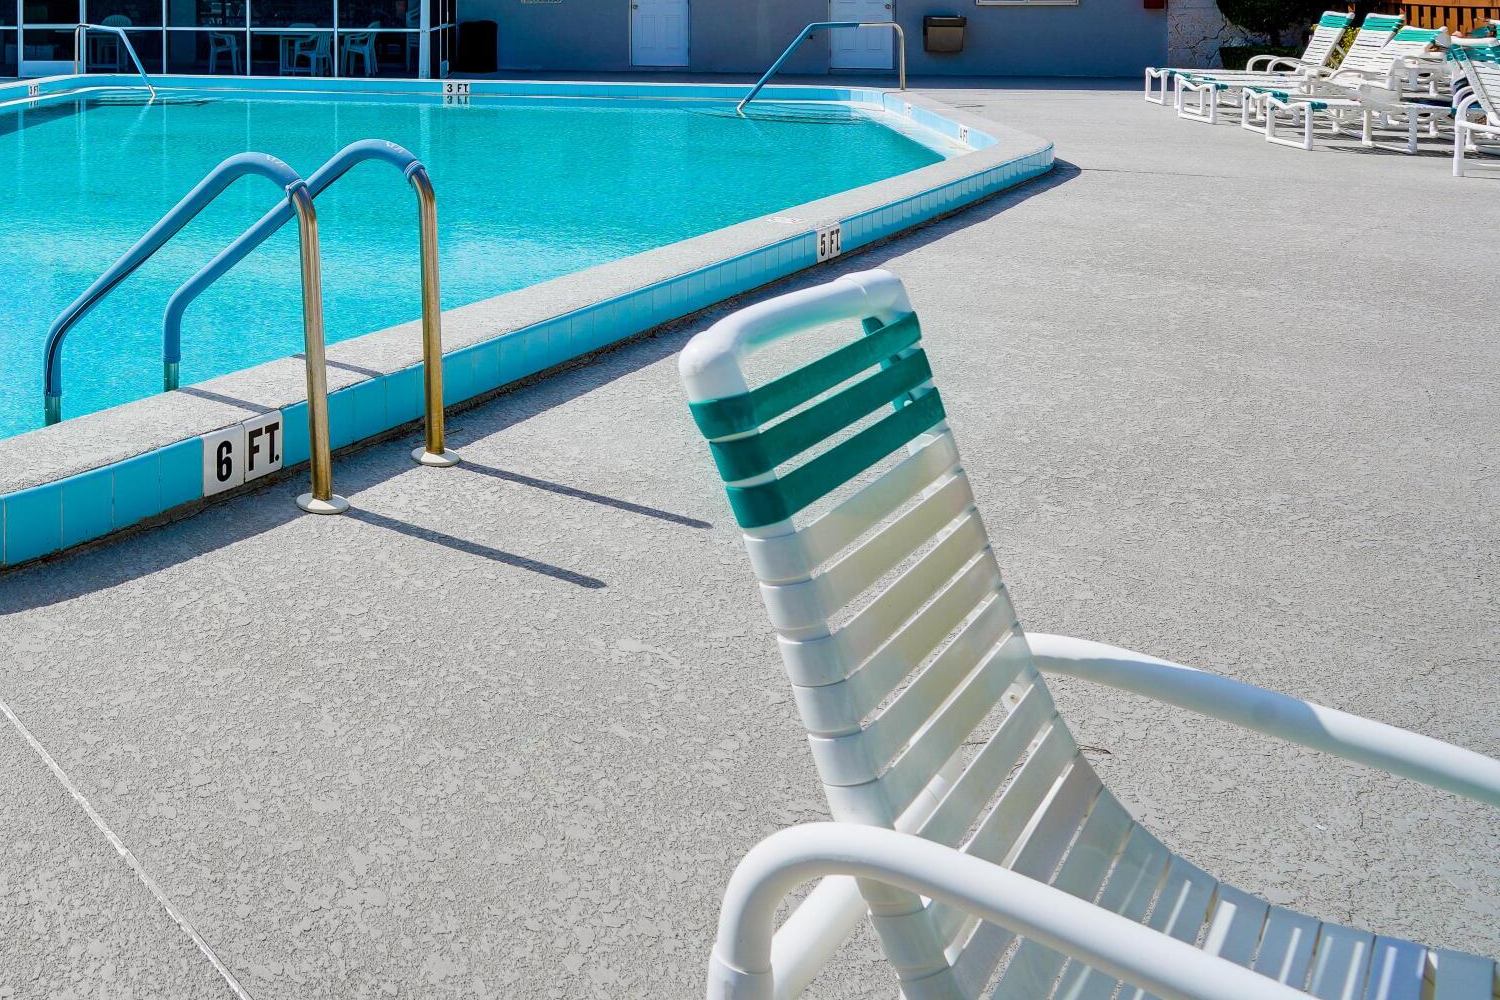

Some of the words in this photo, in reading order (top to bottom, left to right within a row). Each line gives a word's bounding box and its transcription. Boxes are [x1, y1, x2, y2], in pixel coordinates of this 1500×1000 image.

[446, 83, 453, 93] 3
[820, 233, 826, 257] 5
[216, 440, 233, 482] 6
[248, 421, 280, 472] FT.
